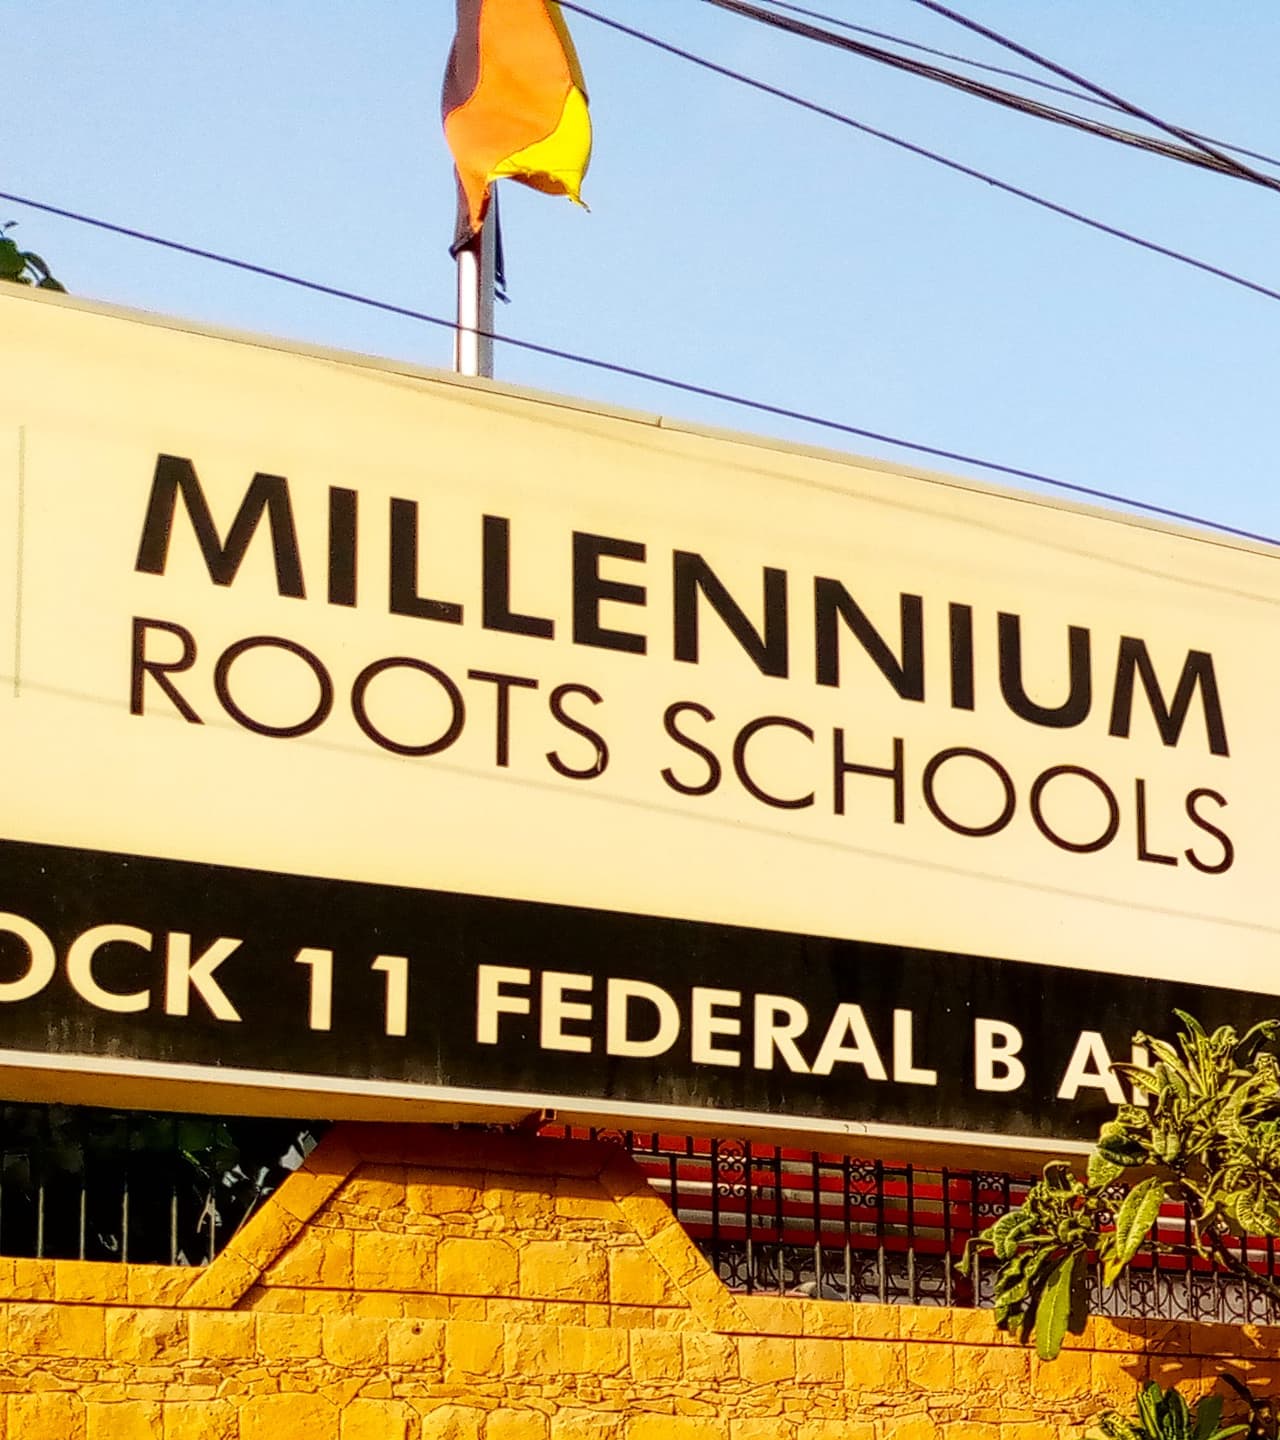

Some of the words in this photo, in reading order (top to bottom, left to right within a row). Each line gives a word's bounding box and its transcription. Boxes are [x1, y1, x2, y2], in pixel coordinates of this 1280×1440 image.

[135, 453, 1230, 758] MILLENNIUM
[130, 616, 609, 780] ROOTS
[661, 701, 1234, 874] SCHOOLS
[295, 949, 409, 1036] 11
[476, 965, 937, 1085] FEDERAL
[975, 1018, 1026, 1092] B
